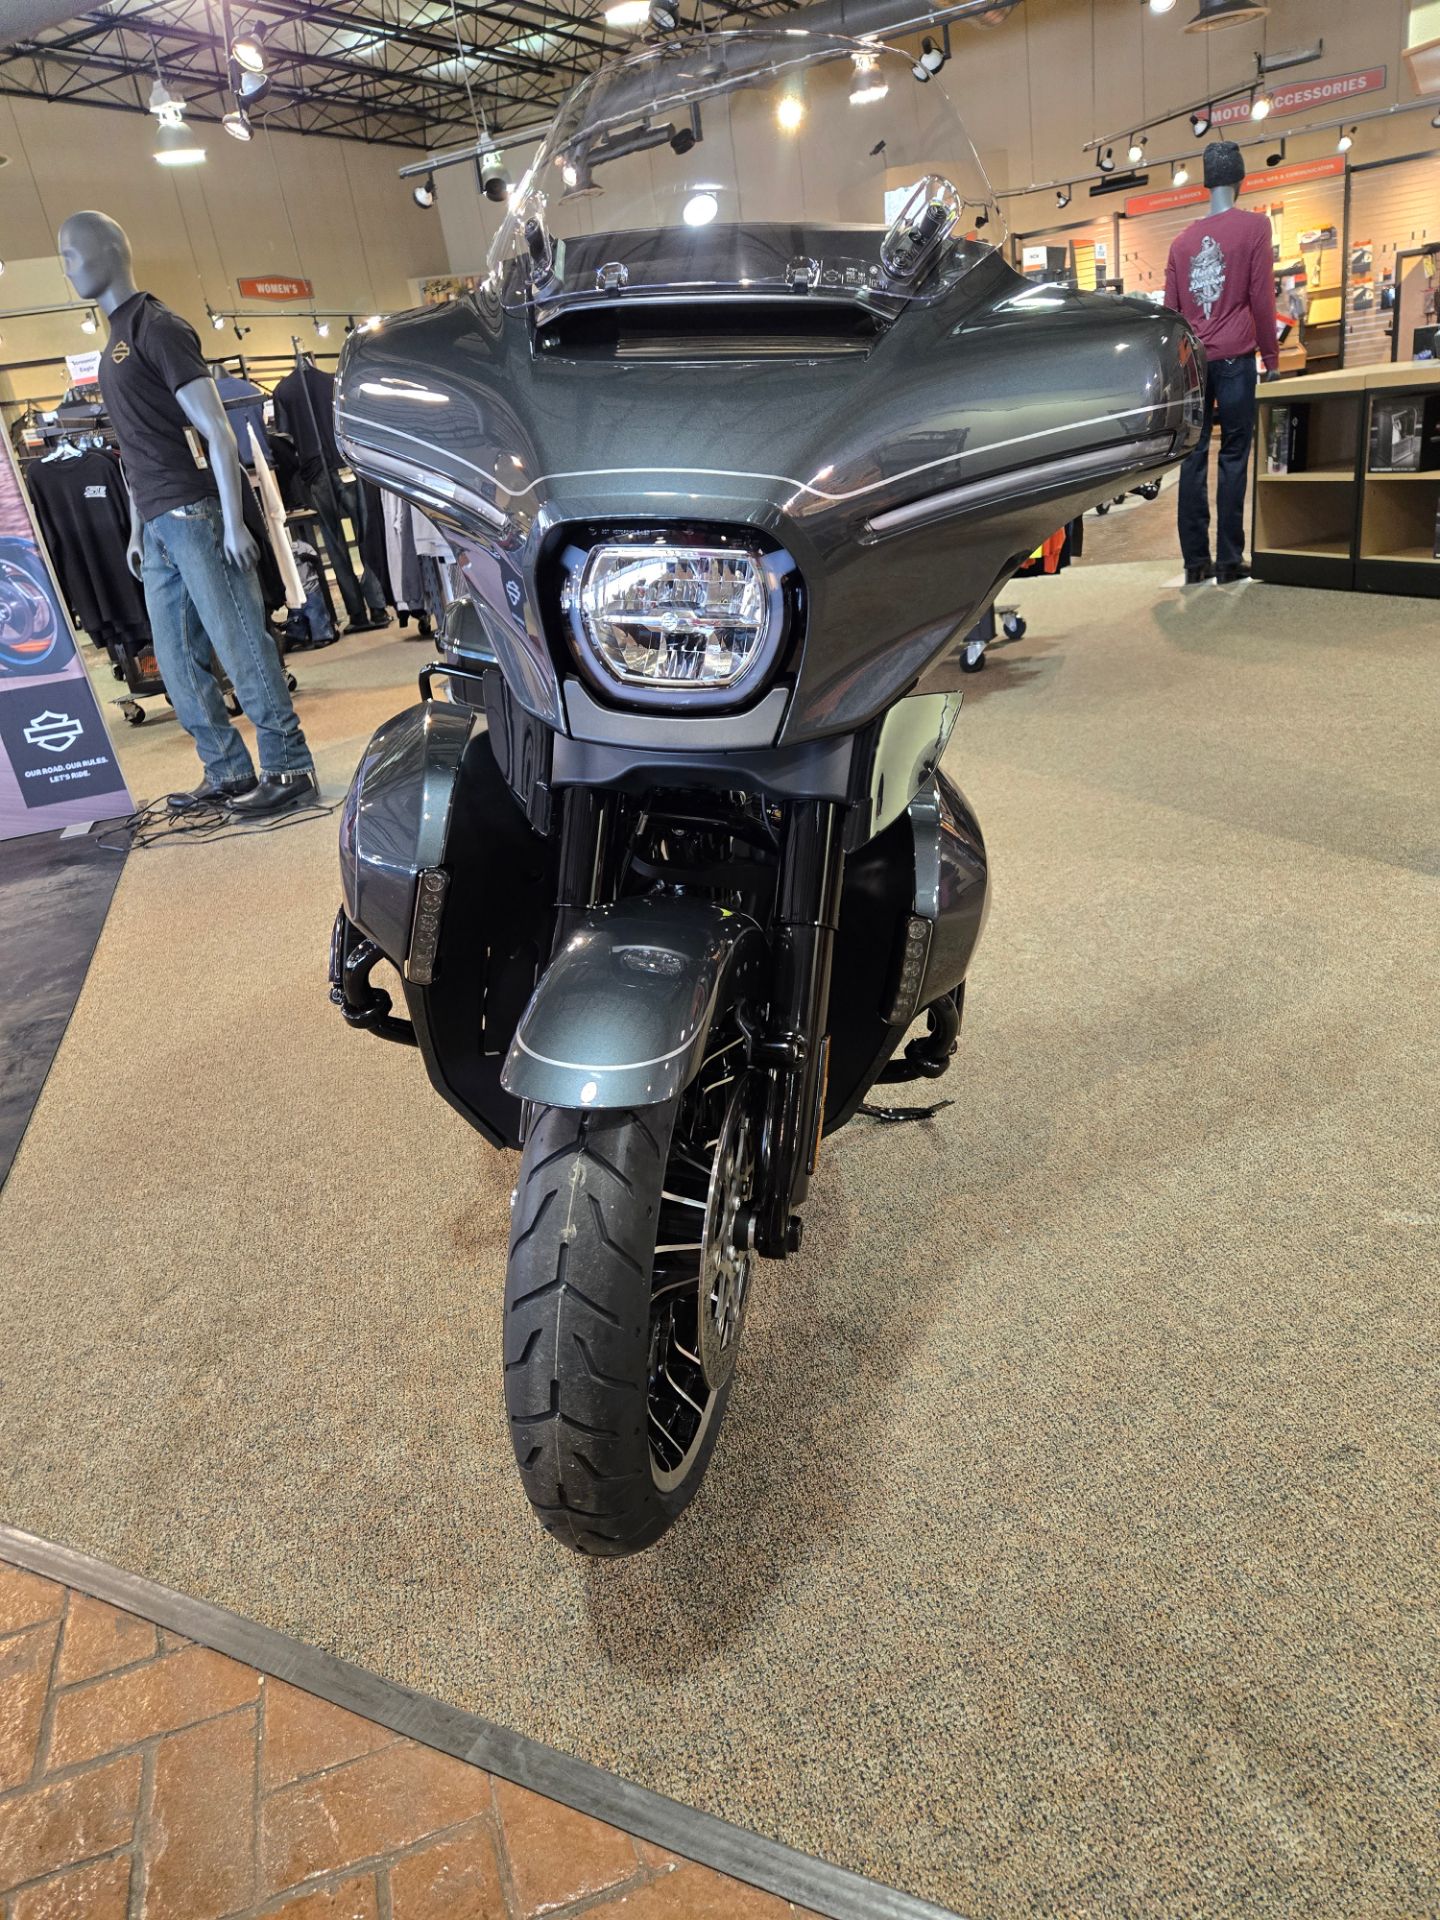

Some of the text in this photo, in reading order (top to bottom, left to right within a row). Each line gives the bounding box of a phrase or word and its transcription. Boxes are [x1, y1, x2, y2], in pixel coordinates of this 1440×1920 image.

[1211, 103, 1253, 122] MOTO
[255, 283, 299, 294] WOMEN'S
[24, 756, 109, 778] OUR ROAD. OUR RULES.
[49, 769, 91, 784] LET'S RIDE.
